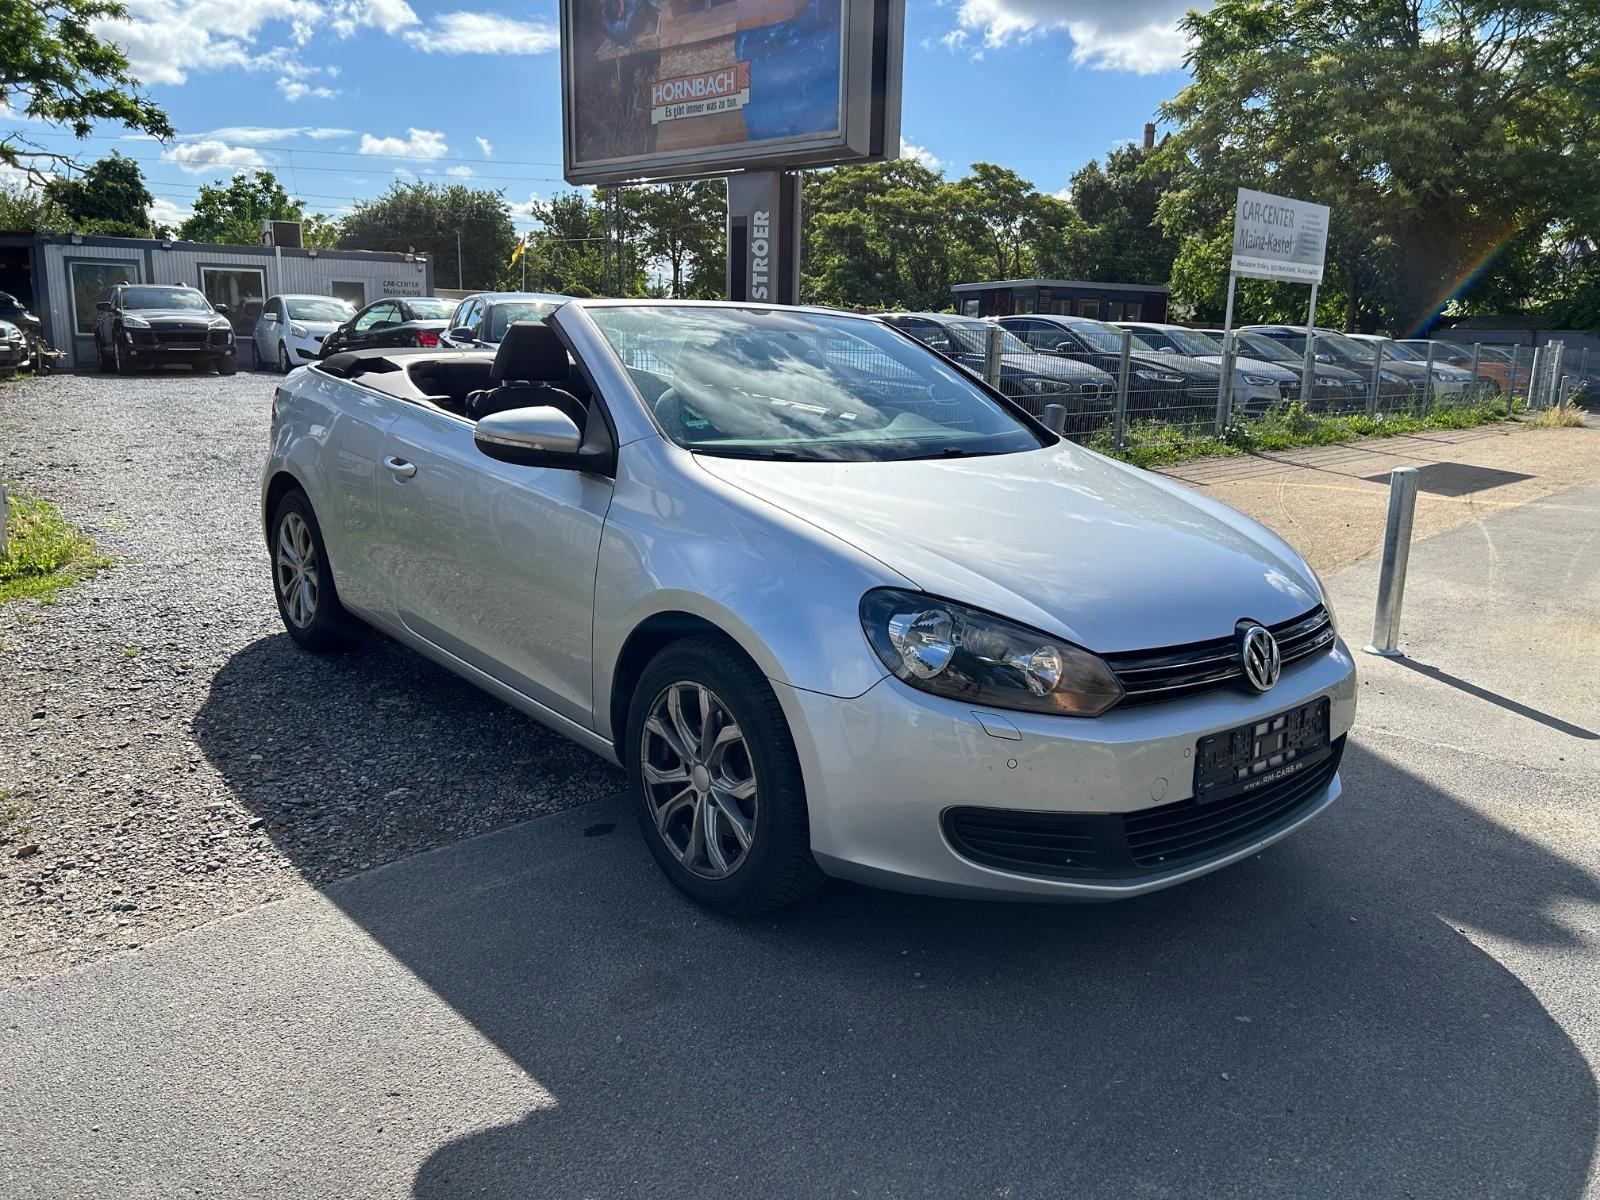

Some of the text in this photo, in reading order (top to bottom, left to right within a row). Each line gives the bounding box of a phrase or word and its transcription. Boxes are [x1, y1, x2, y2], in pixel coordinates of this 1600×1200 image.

[652, 71, 735, 105] HORNBACH
[665, 106, 673, 118] Es
[673, 104, 685, 118] gibt
[686, 102, 704, 114] immer
[706, 100, 717, 111] was
[718, 99, 726, 109] zu
[1242, 200, 1295, 229] CAR-CENTER
[751, 210, 770, 300] STRÖER
[1240, 228, 1293, 254] Mainz-Kastel
[382, 280, 419, 288] CAR-CENTER
[1243, 762, 1303, 791] www.RM-CARS.de
